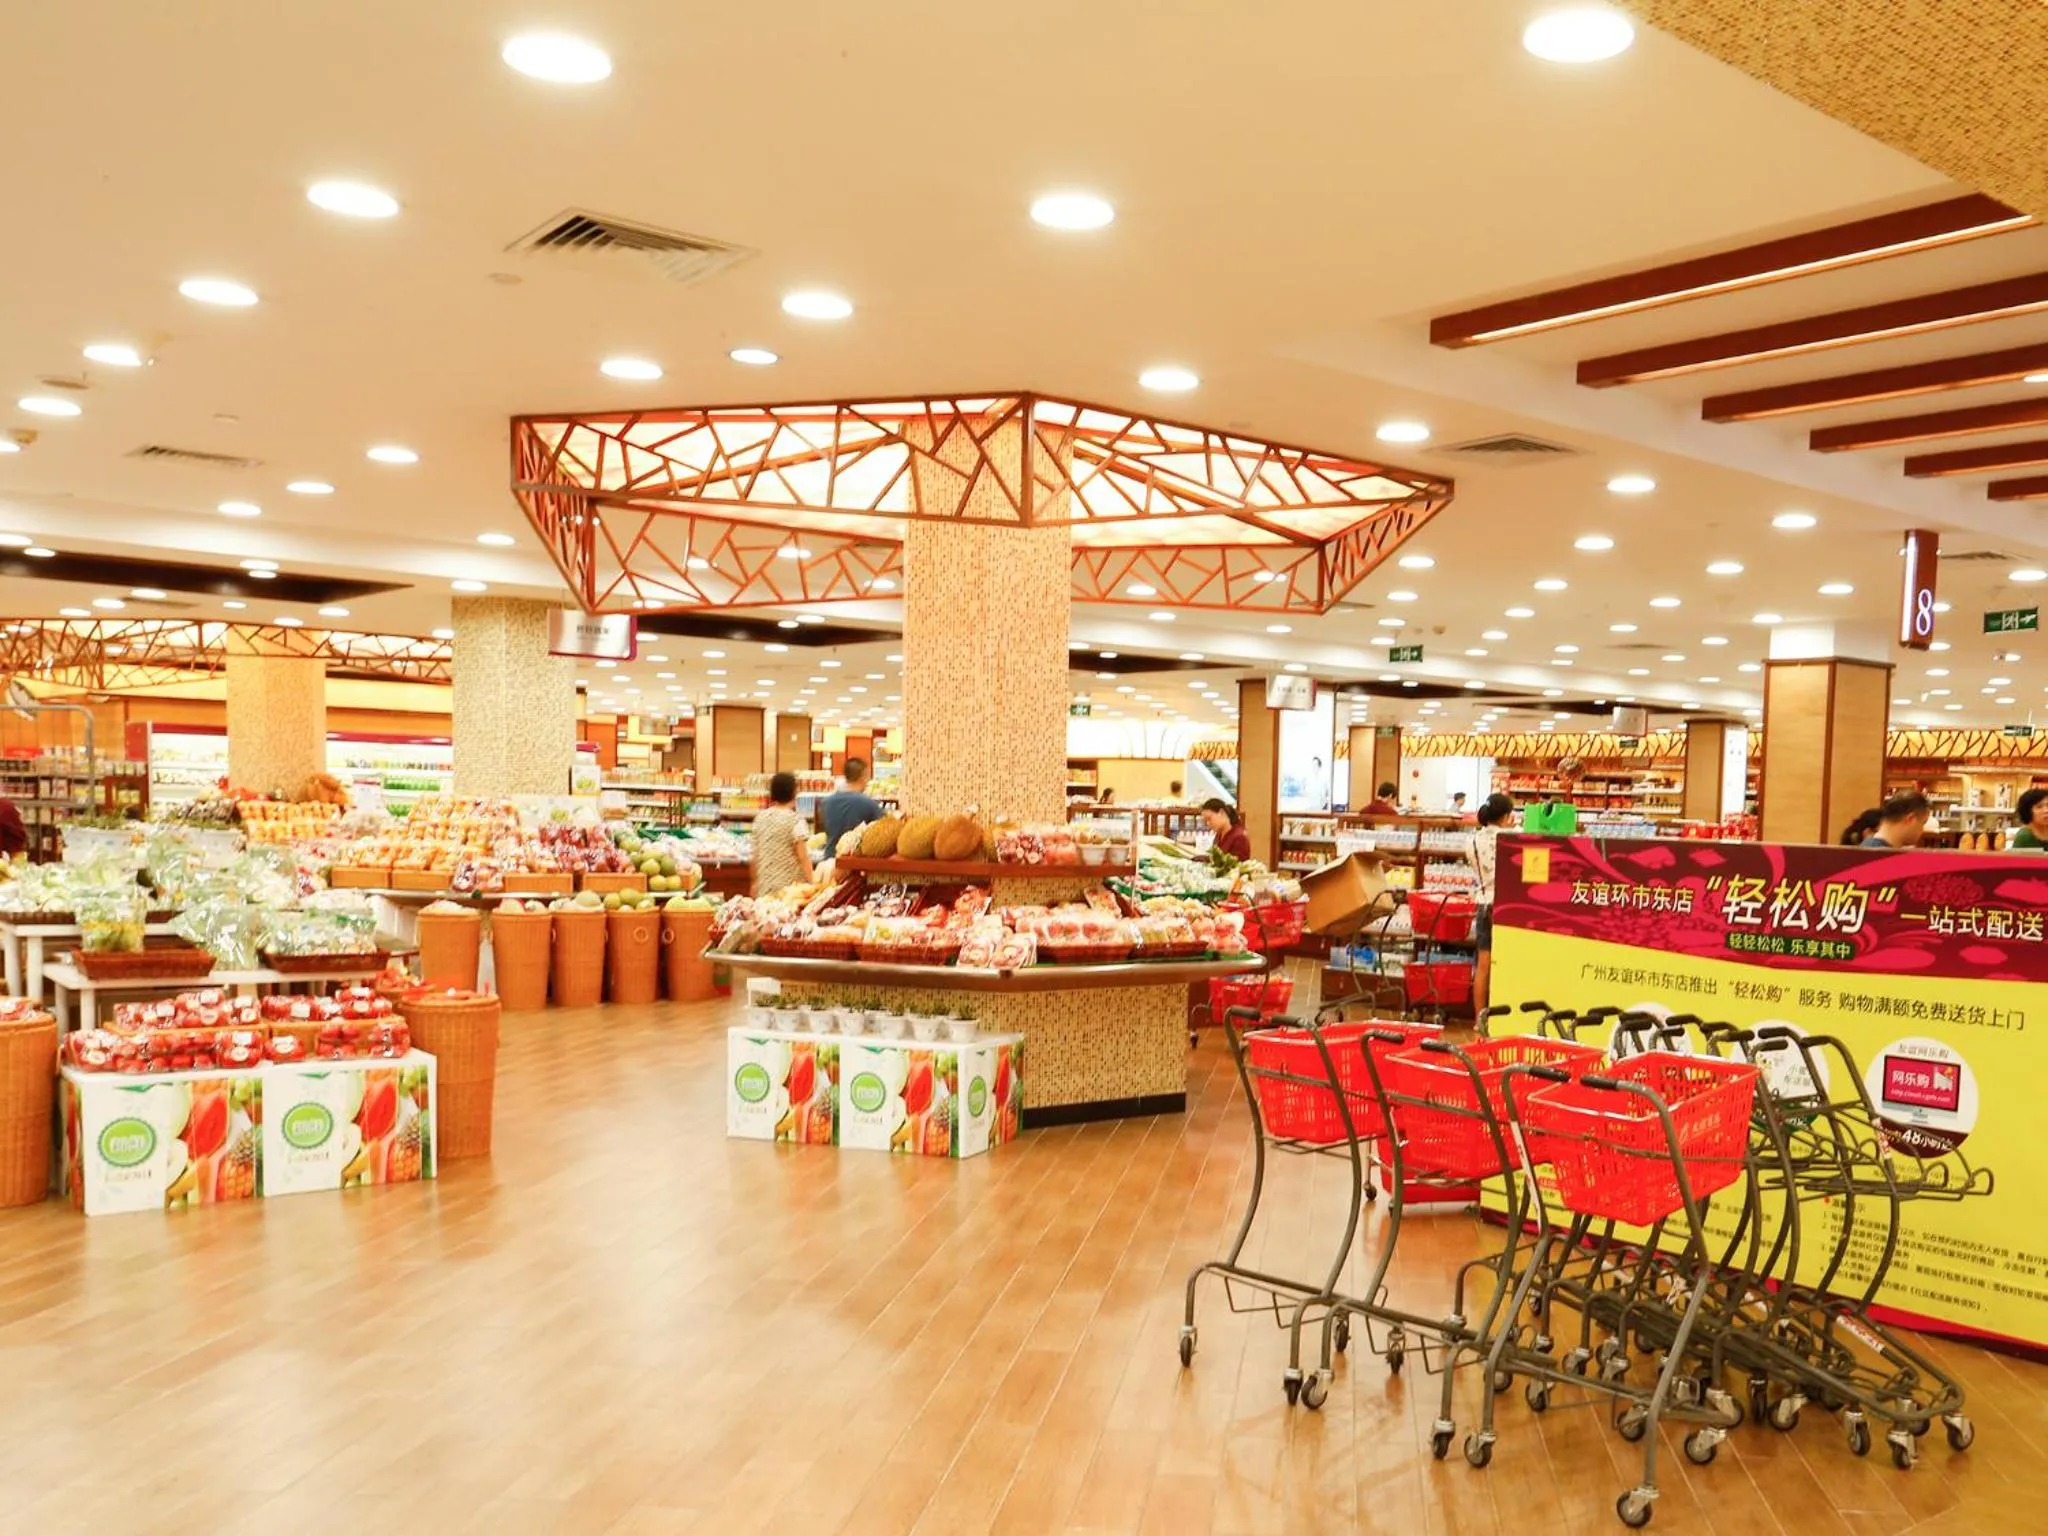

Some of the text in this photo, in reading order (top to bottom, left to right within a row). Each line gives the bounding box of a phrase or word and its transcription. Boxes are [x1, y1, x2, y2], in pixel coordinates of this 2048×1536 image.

[1916, 588, 1932, 635] 8
[1570, 879, 1694, 913] 友谊环市东店
[1901, 904, 2044, 942] 一站式配送
[1728, 932, 1851, 959] 轻轻松松 乐享其中
[1580, 963, 1718, 995] 广州友谊环市东店推出
[1799, 988, 1832, 1009] 服务
[1838, 992, 2025, 1031] 购物满额免费送货上门
